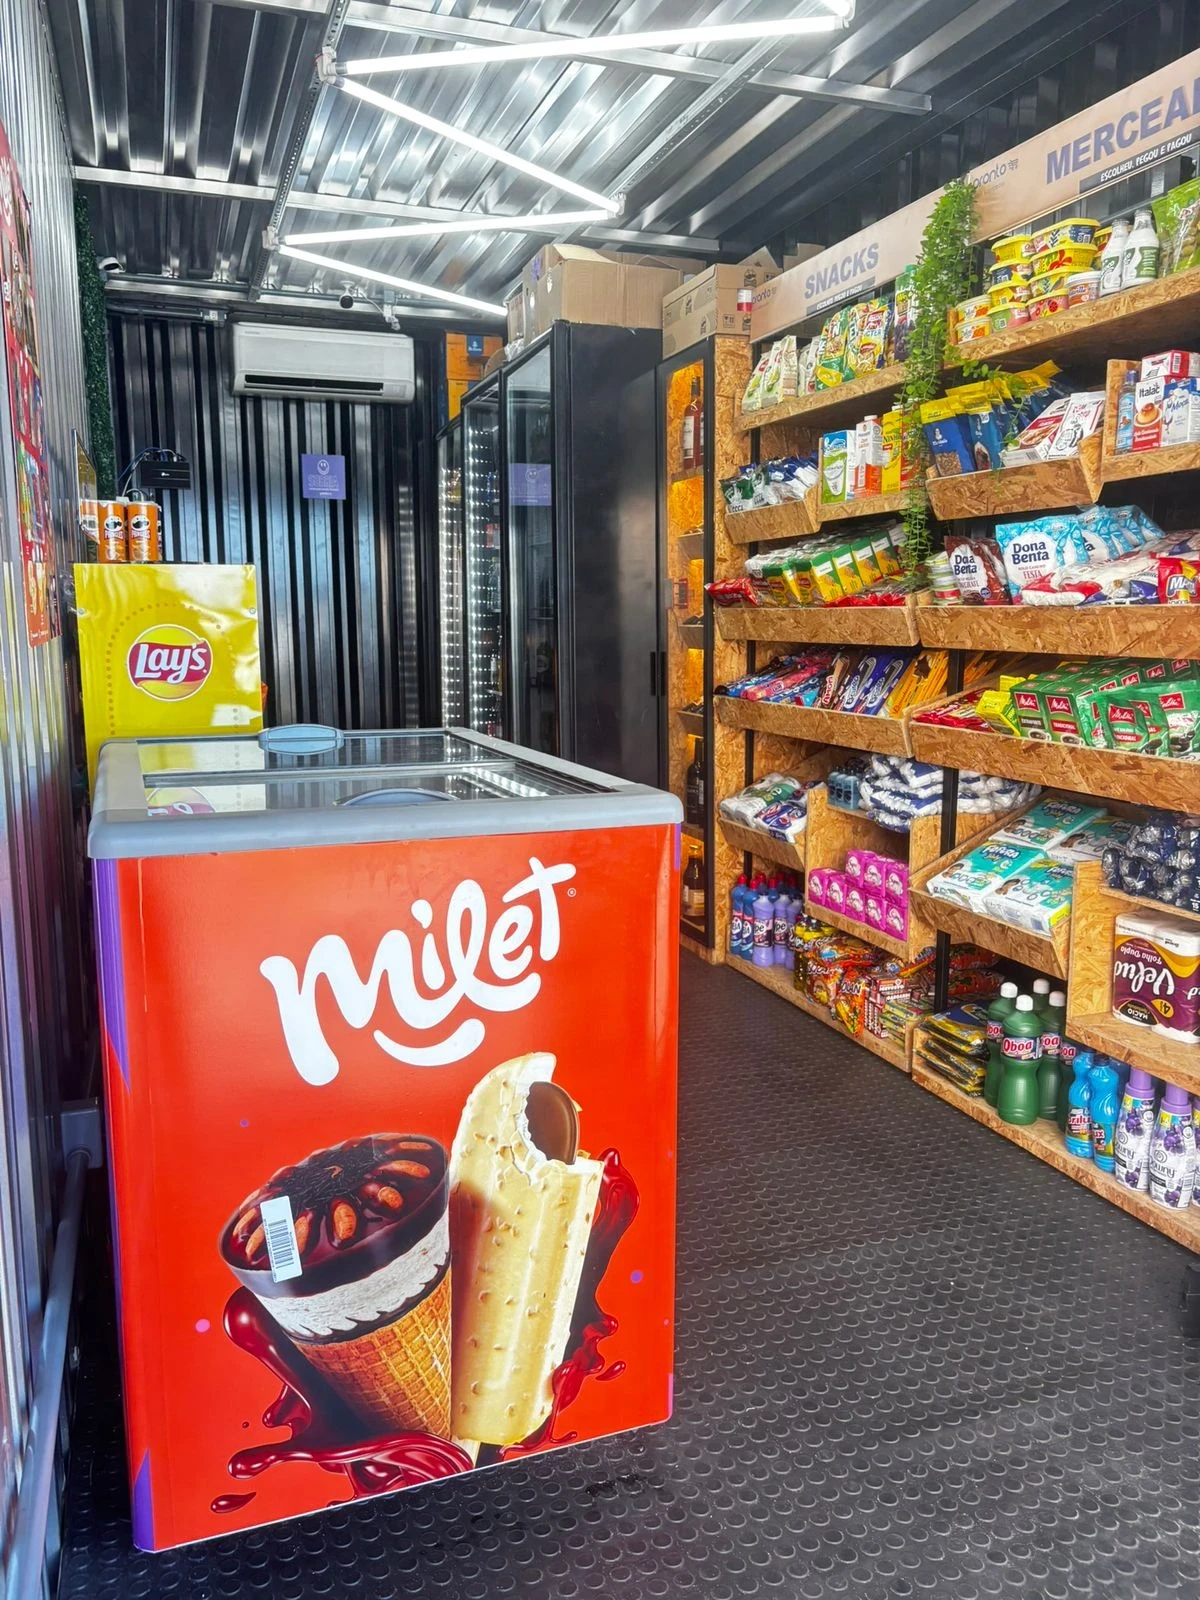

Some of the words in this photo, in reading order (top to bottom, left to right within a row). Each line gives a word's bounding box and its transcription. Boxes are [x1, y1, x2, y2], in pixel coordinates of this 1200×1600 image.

[1135, 148, 1159, 167] PEGOU
[1160, 145, 1166, 155] E
[1167, 133, 1192, 153] PAGOU
[804, 242, 880, 299] SNACKS
[1013, 541, 1046, 554] Dona
[1012, 551, 1050, 565] Benta
[135, 640, 208, 683] Lay's
[1142, 953, 1162, 965] Folha
[1044, 1036, 1059, 1046] oa
[1062, 1047, 1075, 1057] oa
